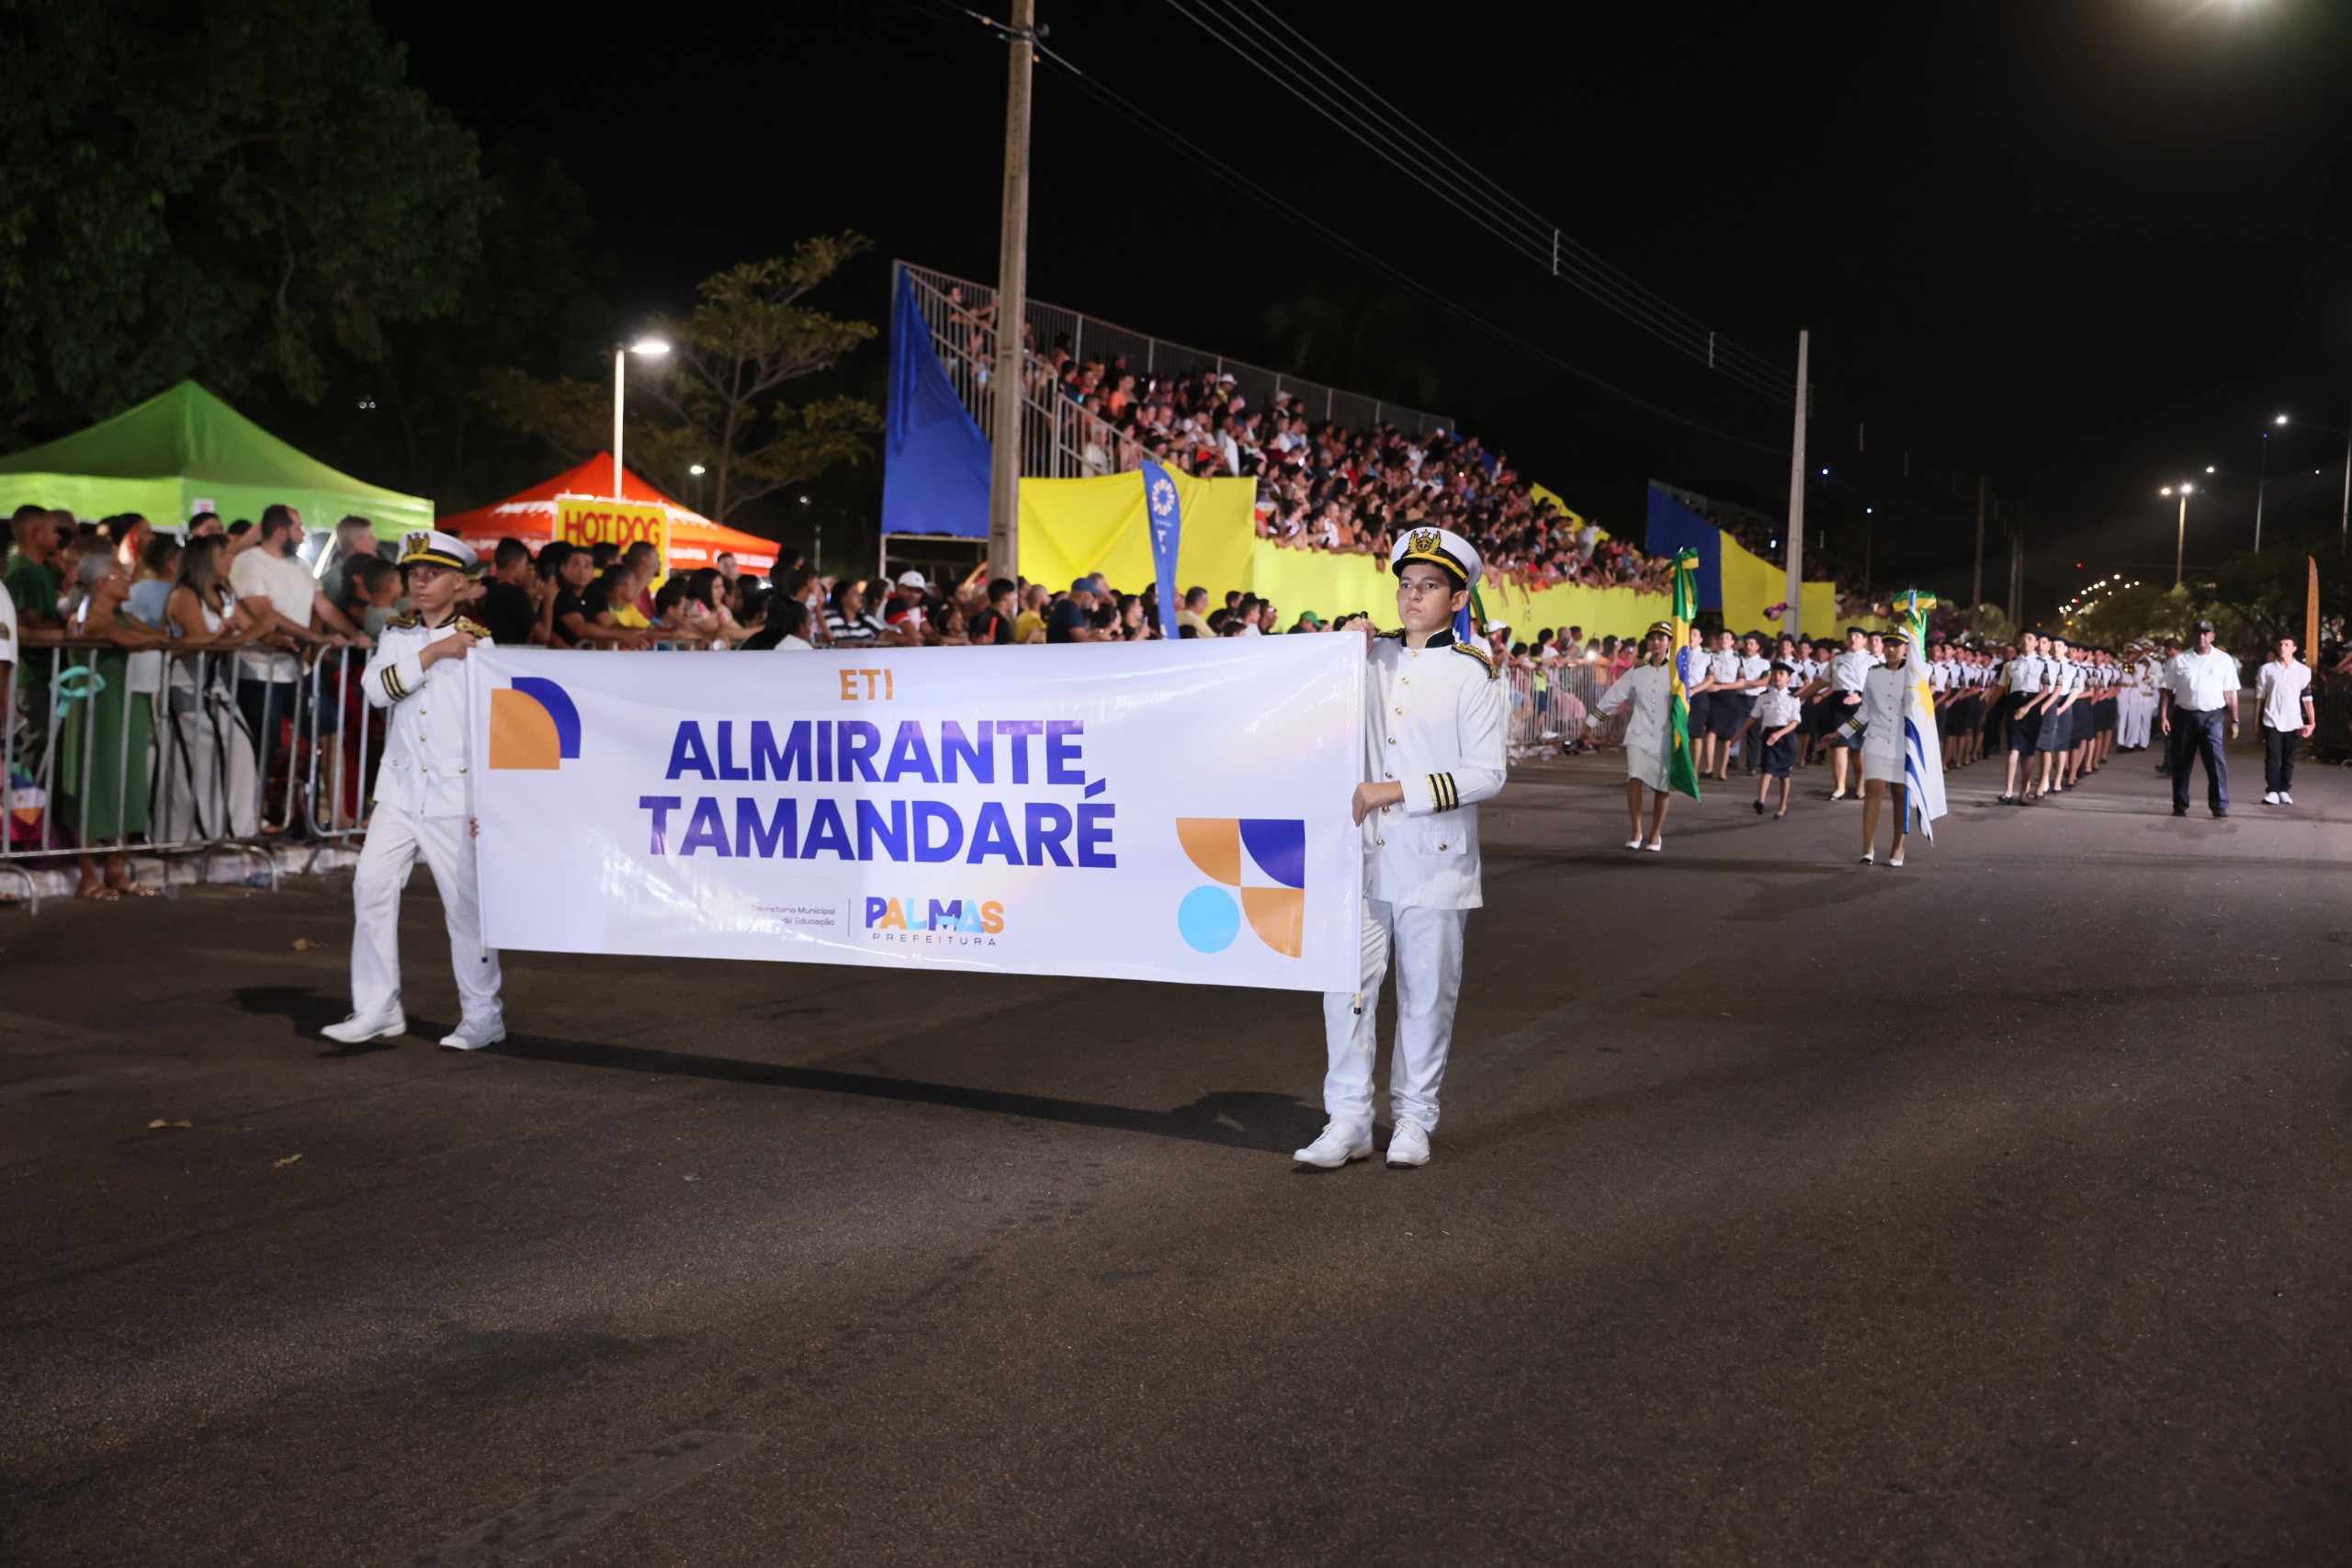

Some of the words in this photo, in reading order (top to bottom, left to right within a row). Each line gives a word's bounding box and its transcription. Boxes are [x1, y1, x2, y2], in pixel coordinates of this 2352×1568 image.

[564, 511, 613, 546] HOT
[616, 514, 661, 548] DOG
[839, 669, 893, 701] ETI
[665, 720, 1086, 784] ALMIRANTE
[639, 777, 1117, 869] TAMANDARÉ
[751, 905, 797, 914] Secretaria
[797, 906, 836, 916] Municipal
[795, 917, 835, 927] Educação
[865, 897, 1004, 934] PALMAS
[873, 932, 996, 946] PREFEITURA
